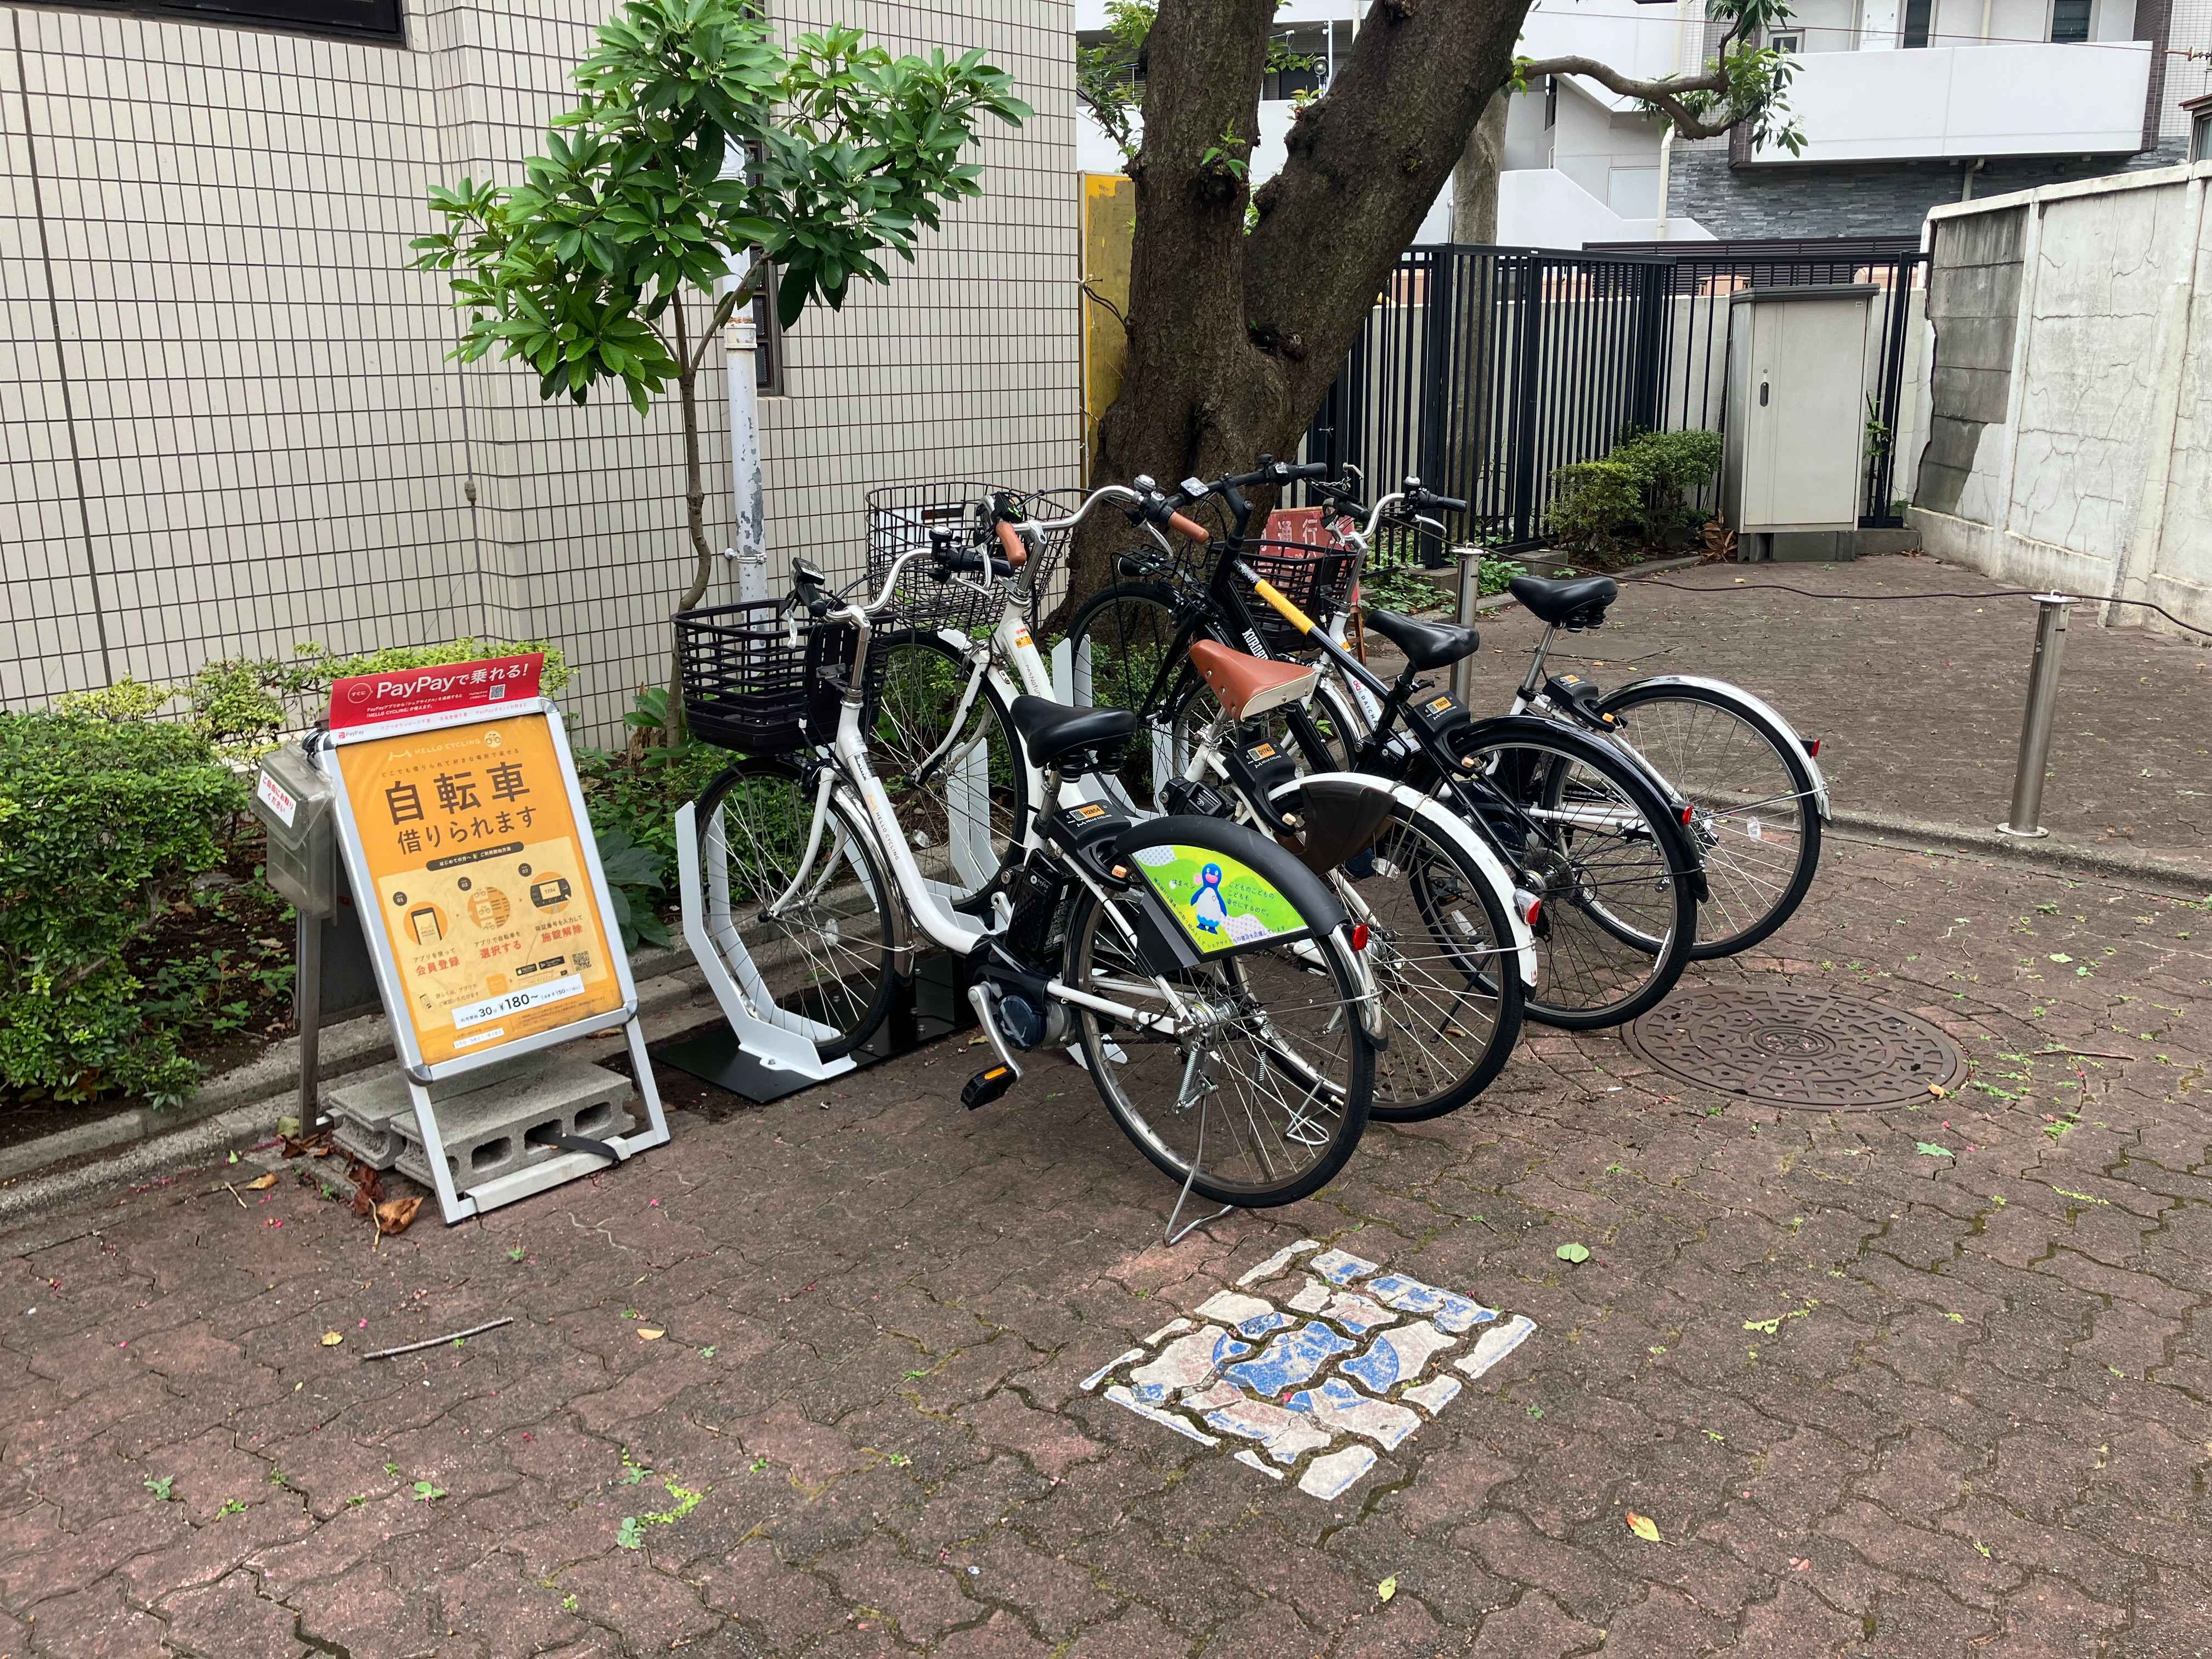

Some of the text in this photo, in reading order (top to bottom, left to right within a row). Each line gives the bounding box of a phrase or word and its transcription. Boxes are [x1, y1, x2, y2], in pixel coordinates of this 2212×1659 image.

[415, 738, 481, 755] HELLO CYCLING
[385, 761, 531, 826] 自転車
[398, 806, 537, 855] 借りられます
[876, 811, 900, 861] HELLO CYCLING
[415, 956, 461, 977] 会員登録
[479, 940, 522, 959] 選択する
